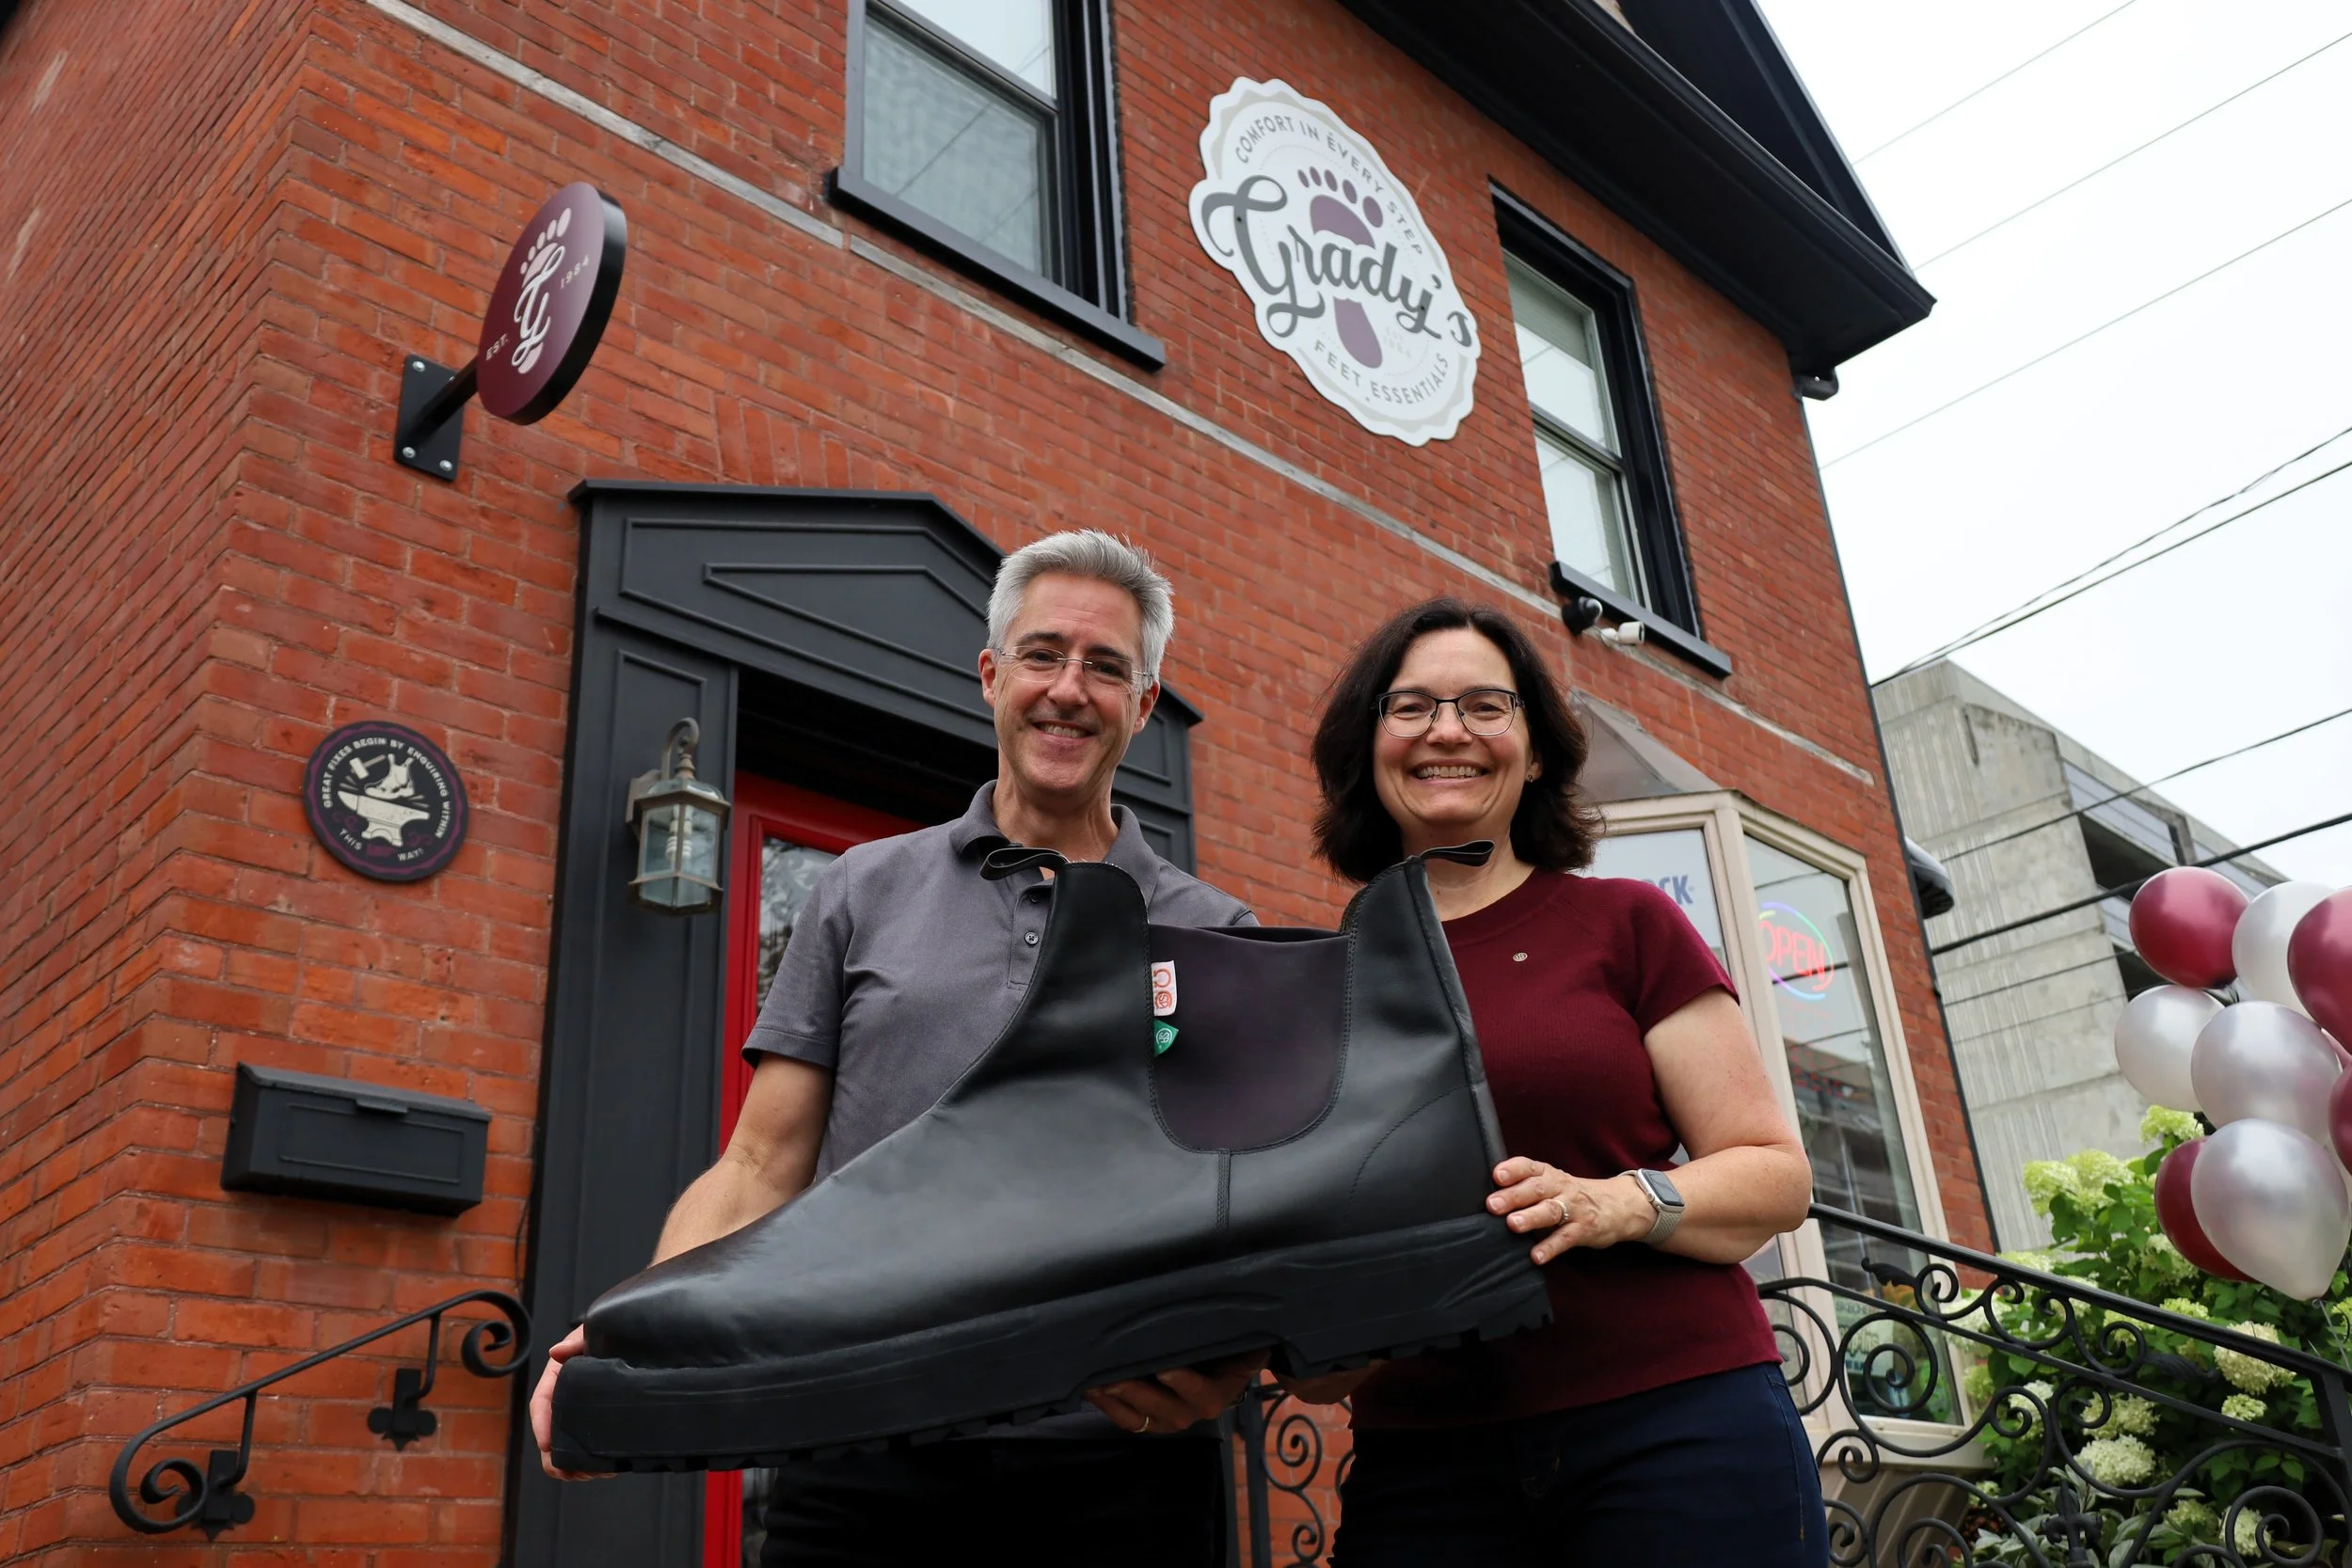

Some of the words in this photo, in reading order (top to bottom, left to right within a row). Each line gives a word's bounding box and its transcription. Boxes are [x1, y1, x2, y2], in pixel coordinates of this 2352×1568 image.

[1235, 115, 1295, 164] COMFORT
[1299, 119, 1320, 141] IN
[1327, 133, 1384, 194] EVERY
[1388, 200, 1423, 255] STEP
[560, 254, 590, 290] 1984
[1200, 174, 1473, 348] Grady's
[485, 333, 509, 362] EST.
[1314, 339, 1361, 388] FEET
[1370, 353, 1449, 404] ESSENTIALS
[327, 745, 354, 771] FIXES
[353, 736, 388, 751] BEGIN
[389, 739, 405, 751] BY
[321, 772, 334, 809] GREAT
[406, 747, 450, 798] ENQUIRING
[435, 800, 452, 839] WITHIN
[339, 829, 364, 851] THIS
[1760, 919, 1825, 982] OPEN
